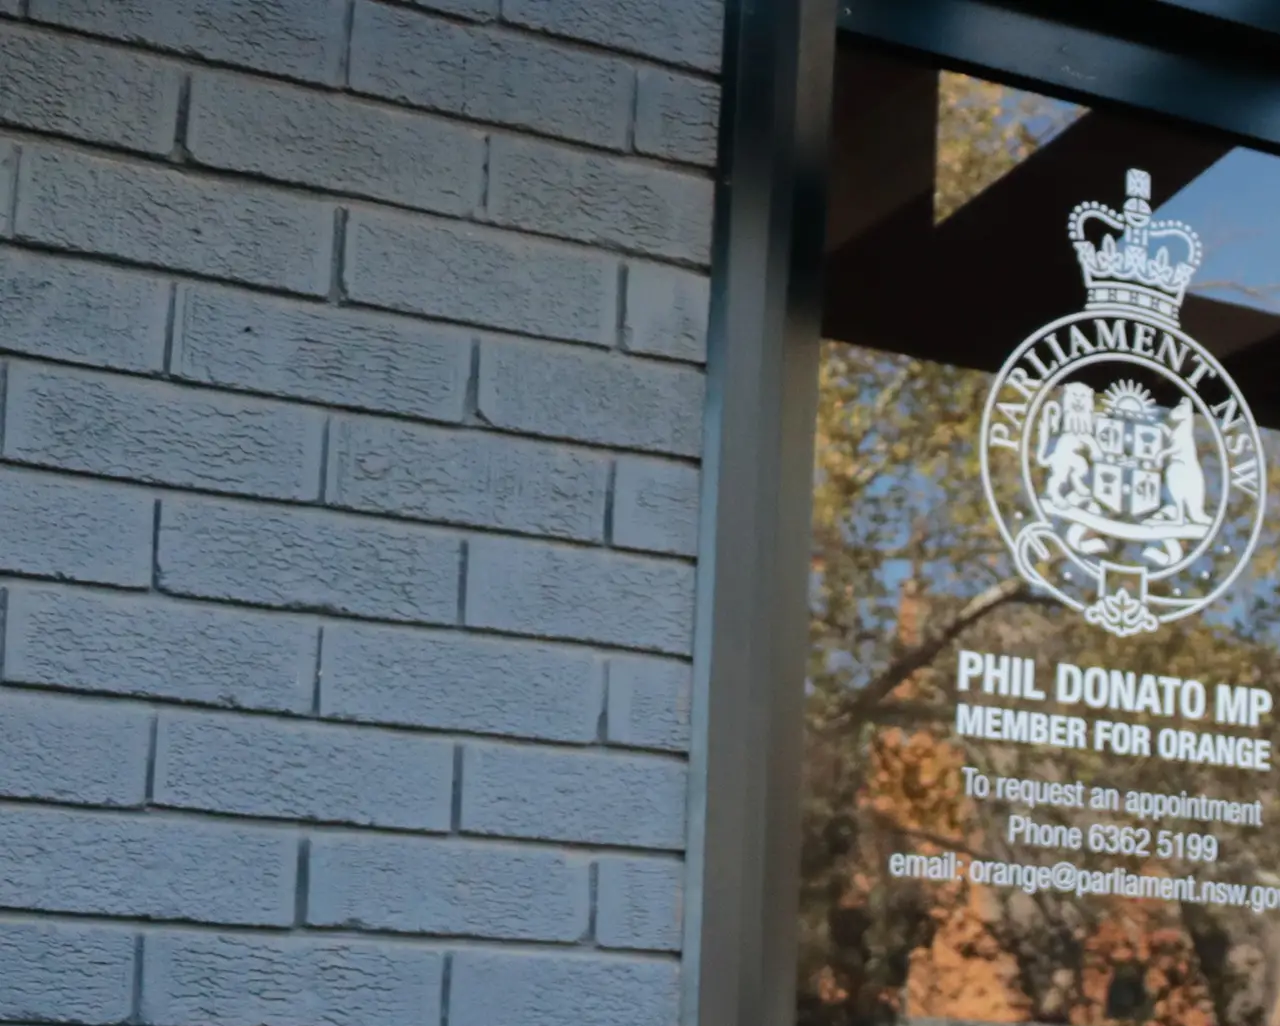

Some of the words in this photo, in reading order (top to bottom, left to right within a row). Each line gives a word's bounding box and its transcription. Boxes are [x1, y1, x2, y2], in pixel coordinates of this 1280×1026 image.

[989, 318, 1216, 452] PARLIAMENT
[1209, 393, 1262, 500] NSW
[956, 650, 1045, 701] PHIL
[1056, 663, 1206, 721] DONATO
[1215, 684, 1273, 728] MP
[955, 704, 1087, 750] MEMBER
[1094, 720, 1151, 758] FOR
[1157, 727, 1271, 772] ORANGE
[961, 767, 990, 798] To
[996, 775, 1084, 812] request
[1090, 786, 1119, 807] an
[1125, 790, 1263, 827] appointment
[889, 851, 963, 882] email:
[1009, 816, 1082, 850] Phone
[1088, 824, 1151, 859] 6362
[1157, 830, 1218, 862] 5199
